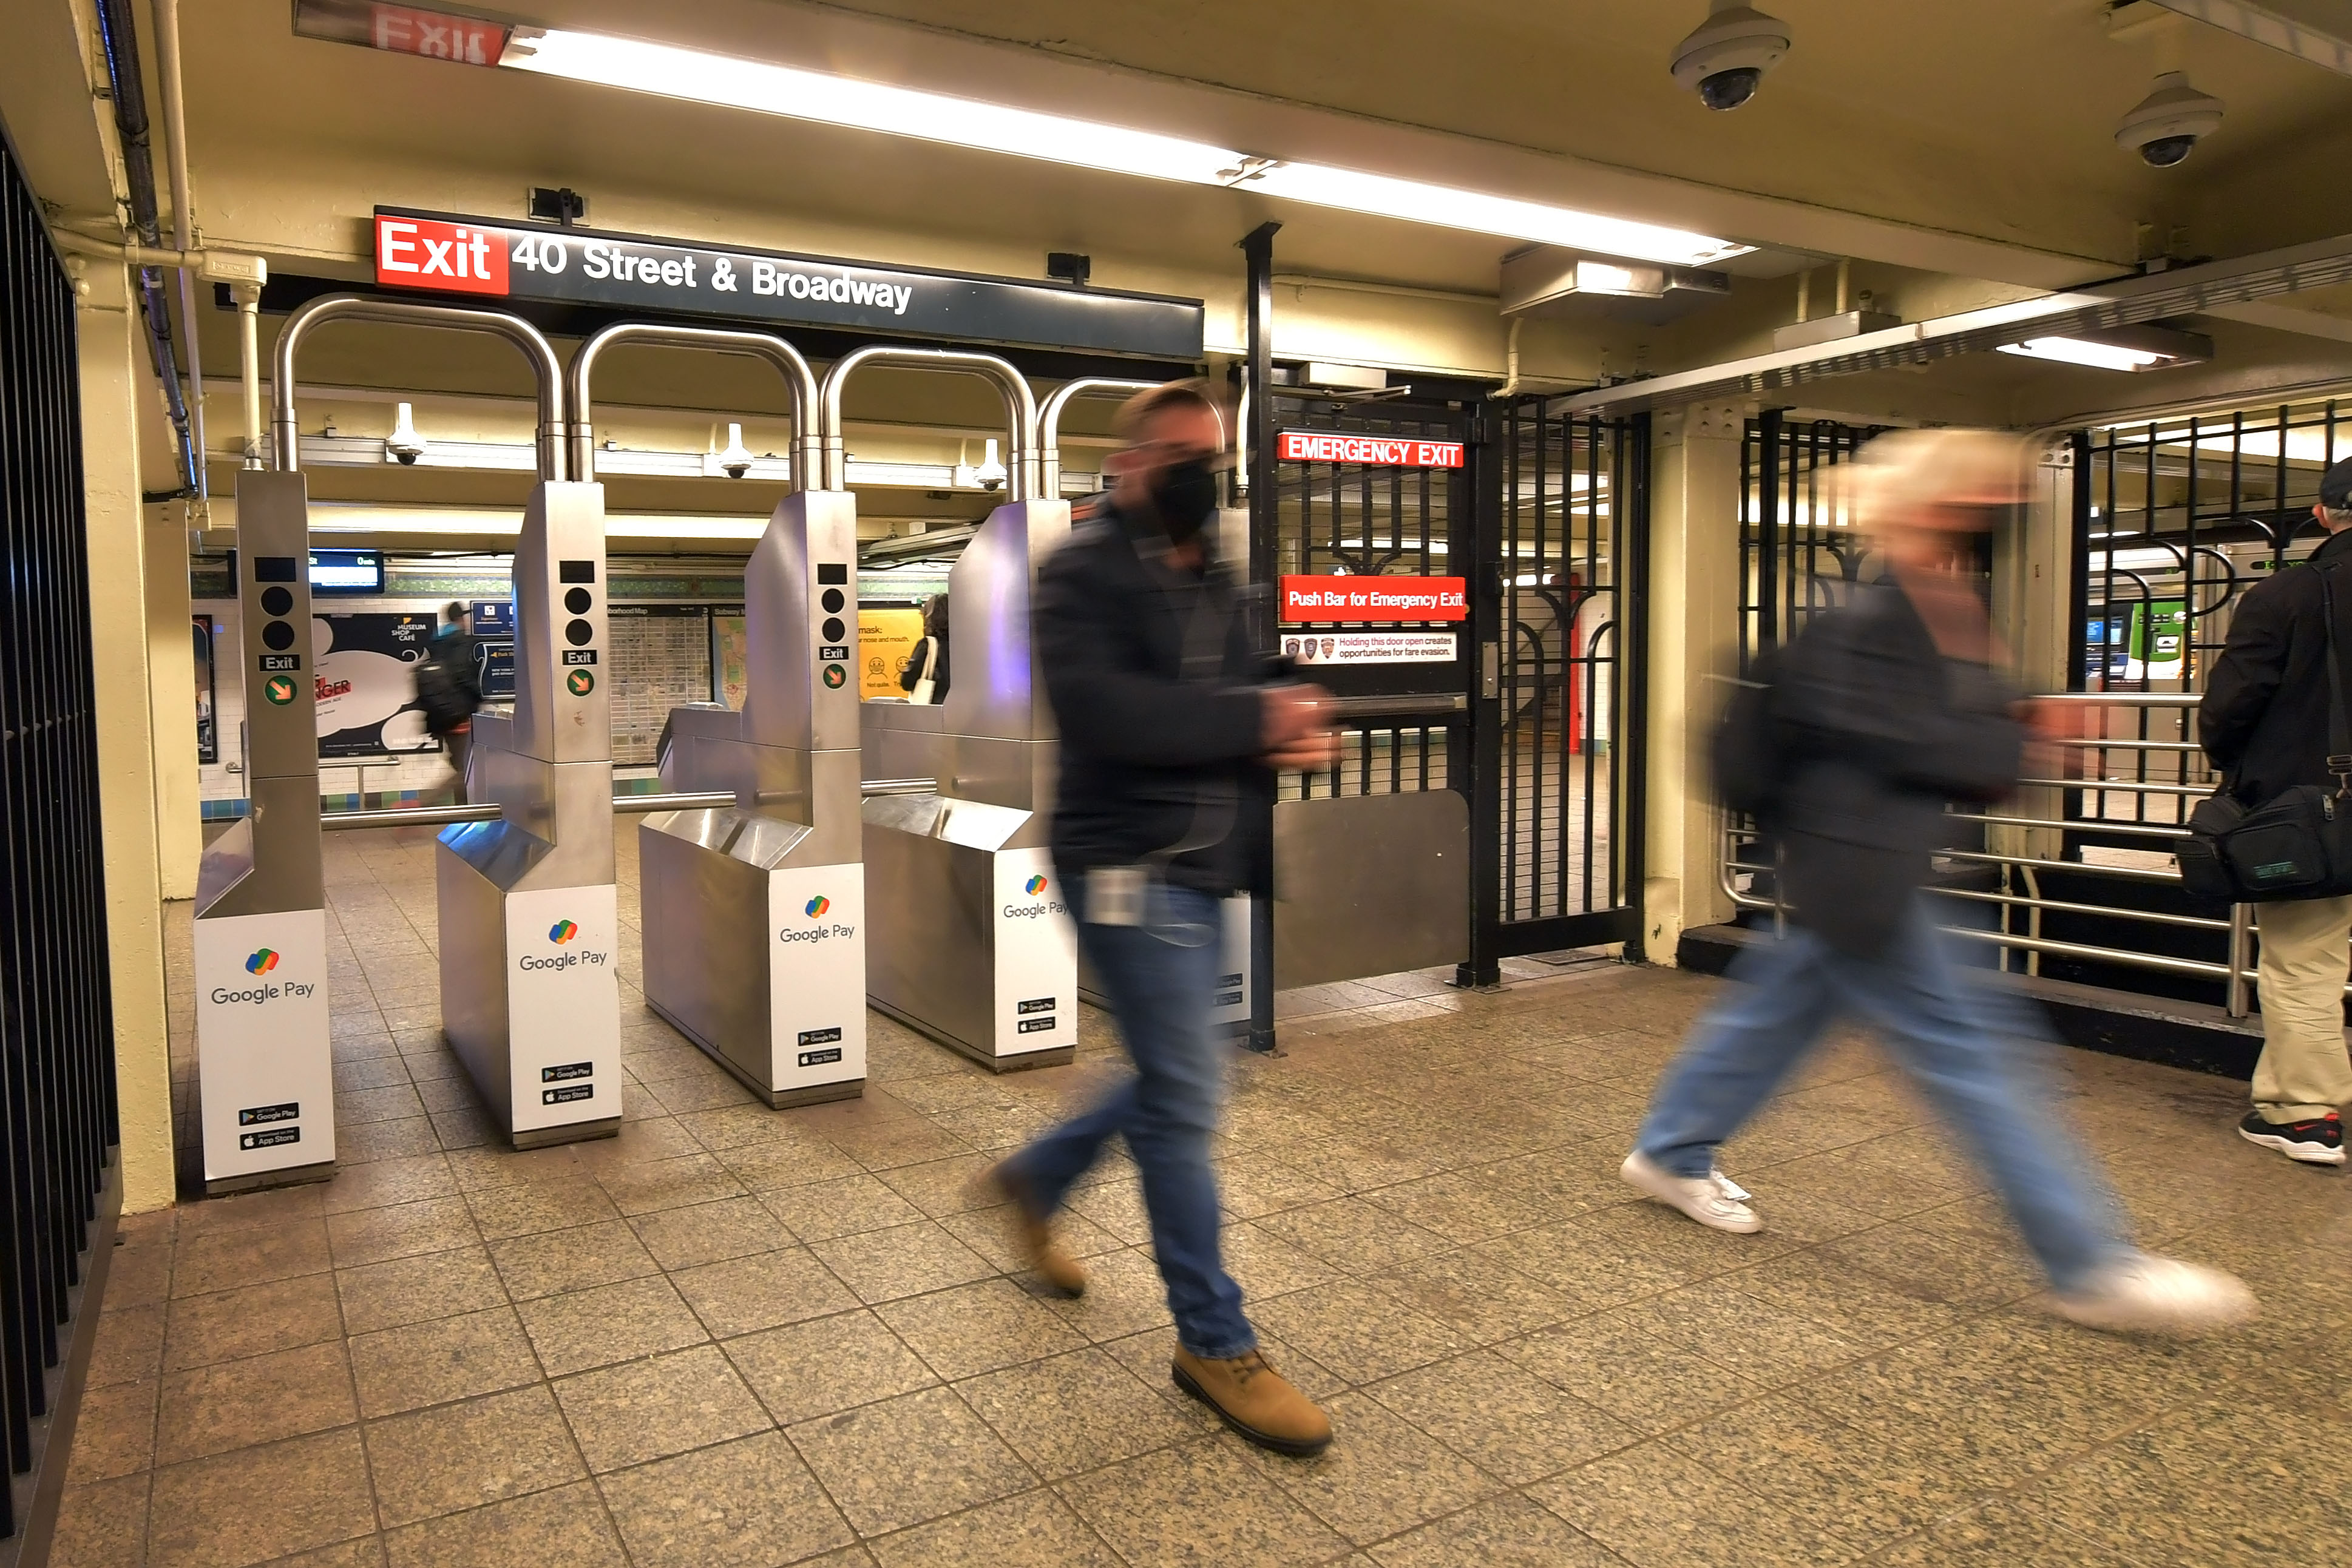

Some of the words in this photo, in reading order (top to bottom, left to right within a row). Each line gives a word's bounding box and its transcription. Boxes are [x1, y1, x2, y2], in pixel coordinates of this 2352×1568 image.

[381, 221, 490, 280] Exit
[512, 236, 568, 274] 40
[583, 243, 697, 288] Street
[711, 257, 738, 292] &
[752, 262, 913, 315] Broadway
[1288, 436, 1410, 464] EMERGENCY
[1418, 444, 1459, 465] EXIT
[1289, 591, 1321, 606] Push
[1324, 592, 1346, 606] Bar
[1350, 592, 1368, 606] for
[1371, 592, 1437, 609] Emergency
[1440, 592, 1463, 606] Exit
[858, 626, 883, 634] mask:
[1339, 637, 1369, 647] Holding
[1371, 637, 1384, 646] this
[1386, 637, 1404, 646] door
[1405, 638, 1424, 647] open
[1425, 637, 1452, 645] creates
[568, 652, 591, 663] Exit
[823, 648, 844, 658] Exit
[1339, 648, 1392, 658] opportunities
[266, 657, 294, 669] Exit
[1003, 902, 1046, 919] Google
[1049, 902, 1068, 916] Pay
[780, 925, 829, 943] Google
[833, 924, 855, 939] Pay
[520, 952, 577, 971] Google
[581, 950, 607, 966] Pay
[211, 984, 279, 1004] Google
[285, 982, 314, 998] Pay
[257, 1111, 281, 1121] Google
